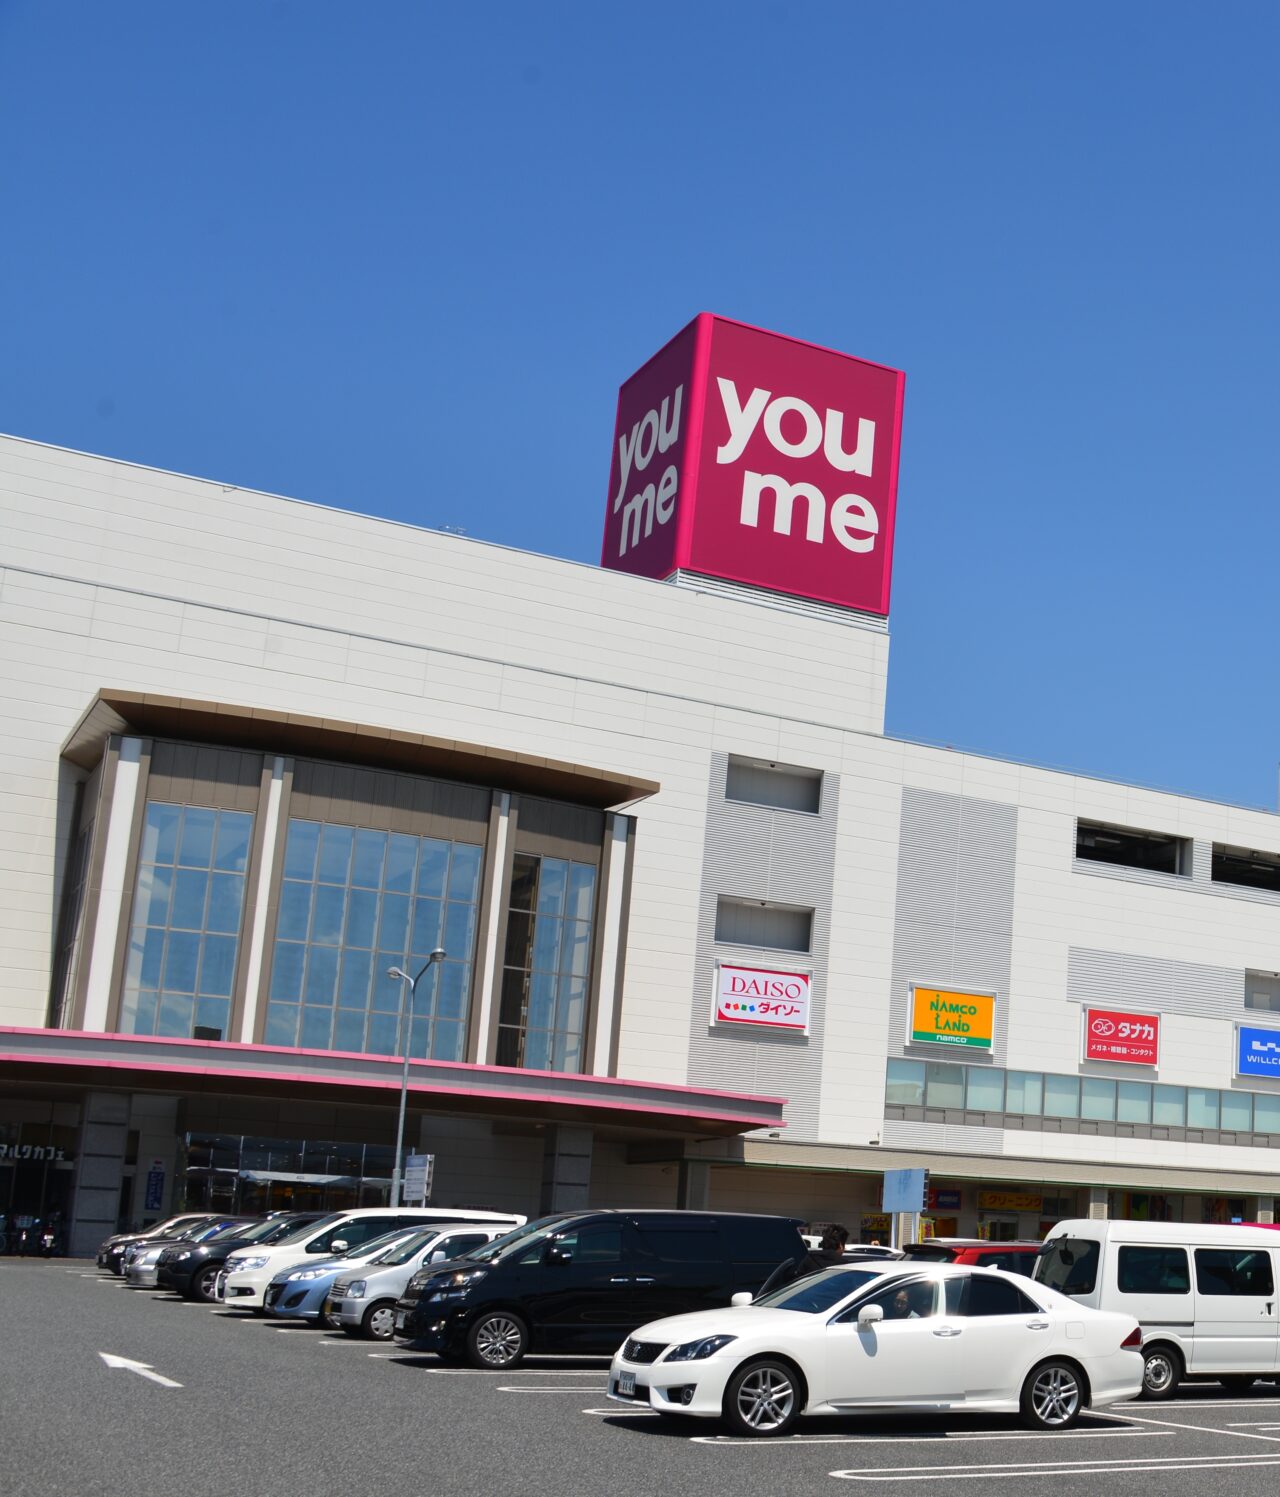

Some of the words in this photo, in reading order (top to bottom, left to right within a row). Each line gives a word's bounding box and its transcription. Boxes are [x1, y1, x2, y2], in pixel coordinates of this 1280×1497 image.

[716, 376, 876, 478] you
[613, 383, 684, 514] you
[619, 464, 679, 558] me
[740, 469, 879, 554] me
[731, 976, 801, 999] DAISO
[758, 1001, 801, 1016] ダイソー
[929, 994, 977, 1016] NAMCO
[935, 1013, 971, 1033] LAND
[1118, 1022, 1154, 1041] タナカ
[936, 1034, 967, 1044] namco
